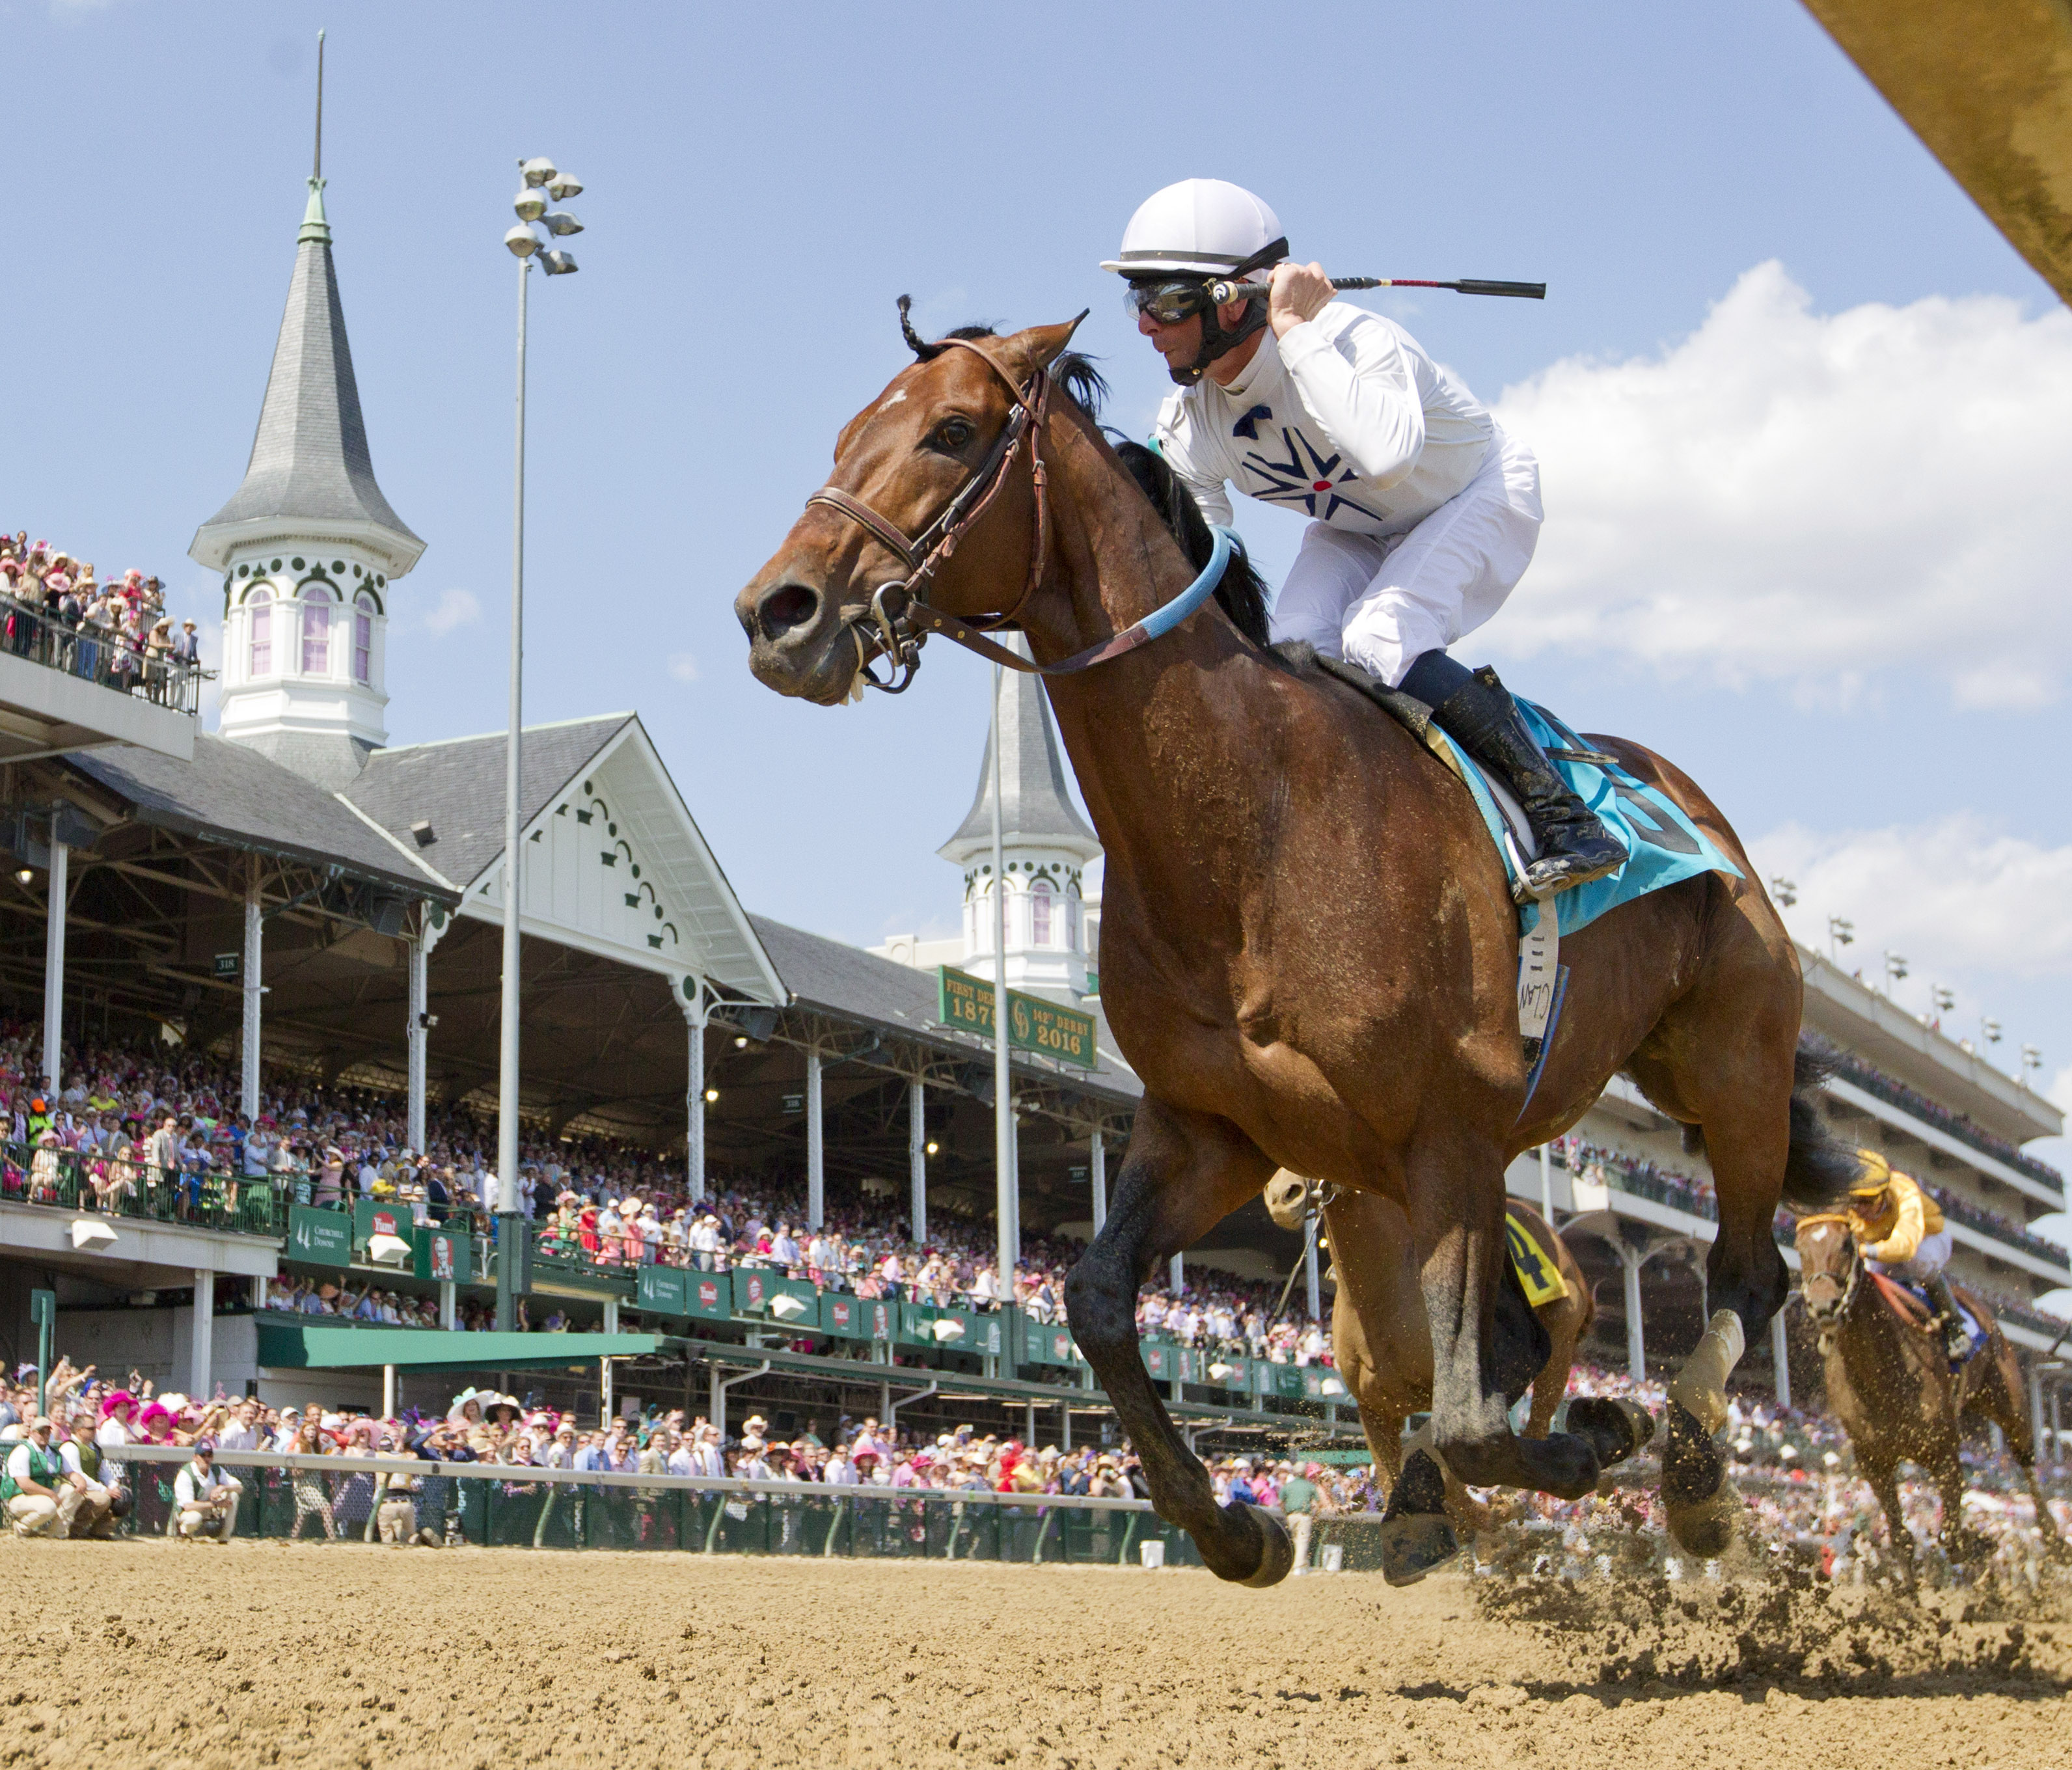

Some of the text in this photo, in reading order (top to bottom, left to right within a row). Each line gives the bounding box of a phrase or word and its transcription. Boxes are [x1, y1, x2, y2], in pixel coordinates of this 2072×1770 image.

[946, 978, 974, 998] FIRST
[1056, 1015, 1088, 1036] DERBY
[1037, 1025, 1081, 1055] 2016
[374, 1218, 396, 1234] Yum!
[1506, 1220, 1550, 1290] 4
